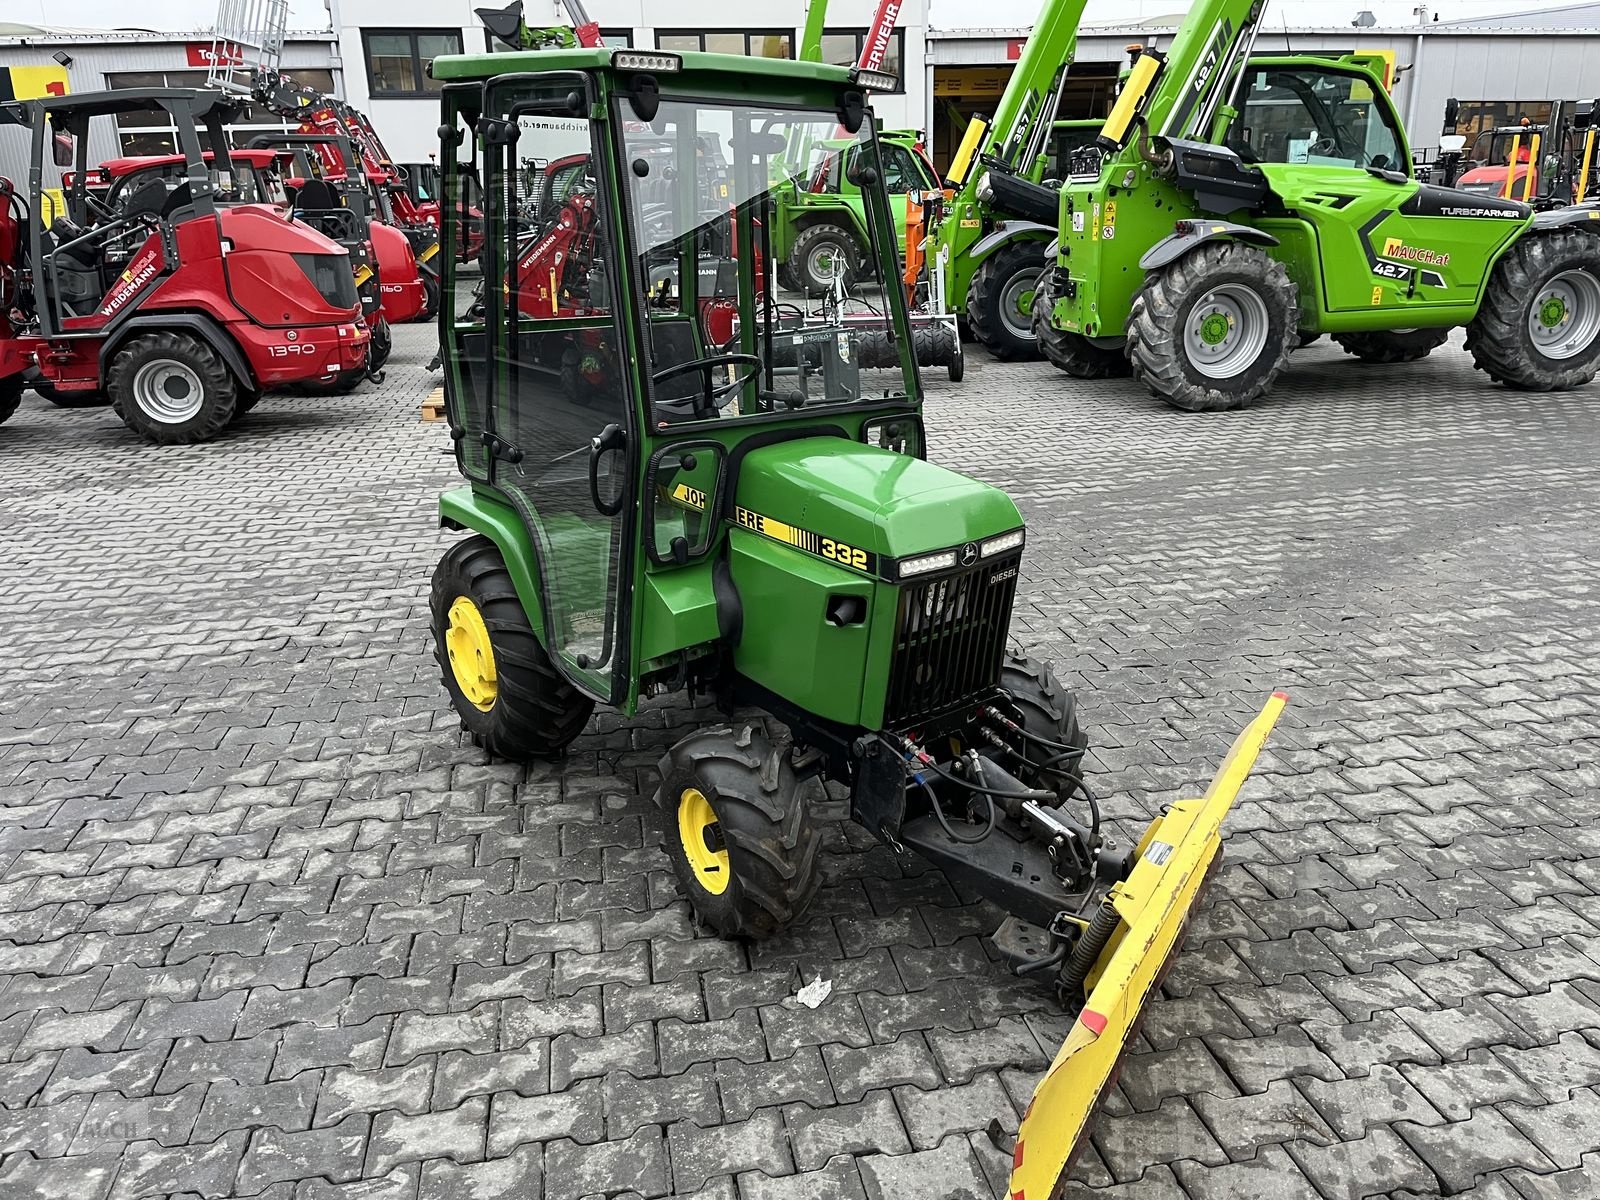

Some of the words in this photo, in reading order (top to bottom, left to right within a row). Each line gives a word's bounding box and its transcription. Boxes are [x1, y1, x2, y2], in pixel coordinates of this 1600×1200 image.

[1194, 50, 1216, 92] 42.7
[1013, 113, 1029, 144] 35.7
[1441, 207, 1519, 218] TURBOFARMER
[521, 234, 557, 269] WEIDEMANN
[1387, 244, 1450, 265] MAUCH.at
[1373, 263, 1409, 279] 42.7
[101, 264, 156, 316] WEIDEMANN
[268, 344, 316, 357] 1390
[739, 508, 765, 532] ERE
[822, 538, 867, 571] 332
[990, 567, 1017, 584] DIESEL
